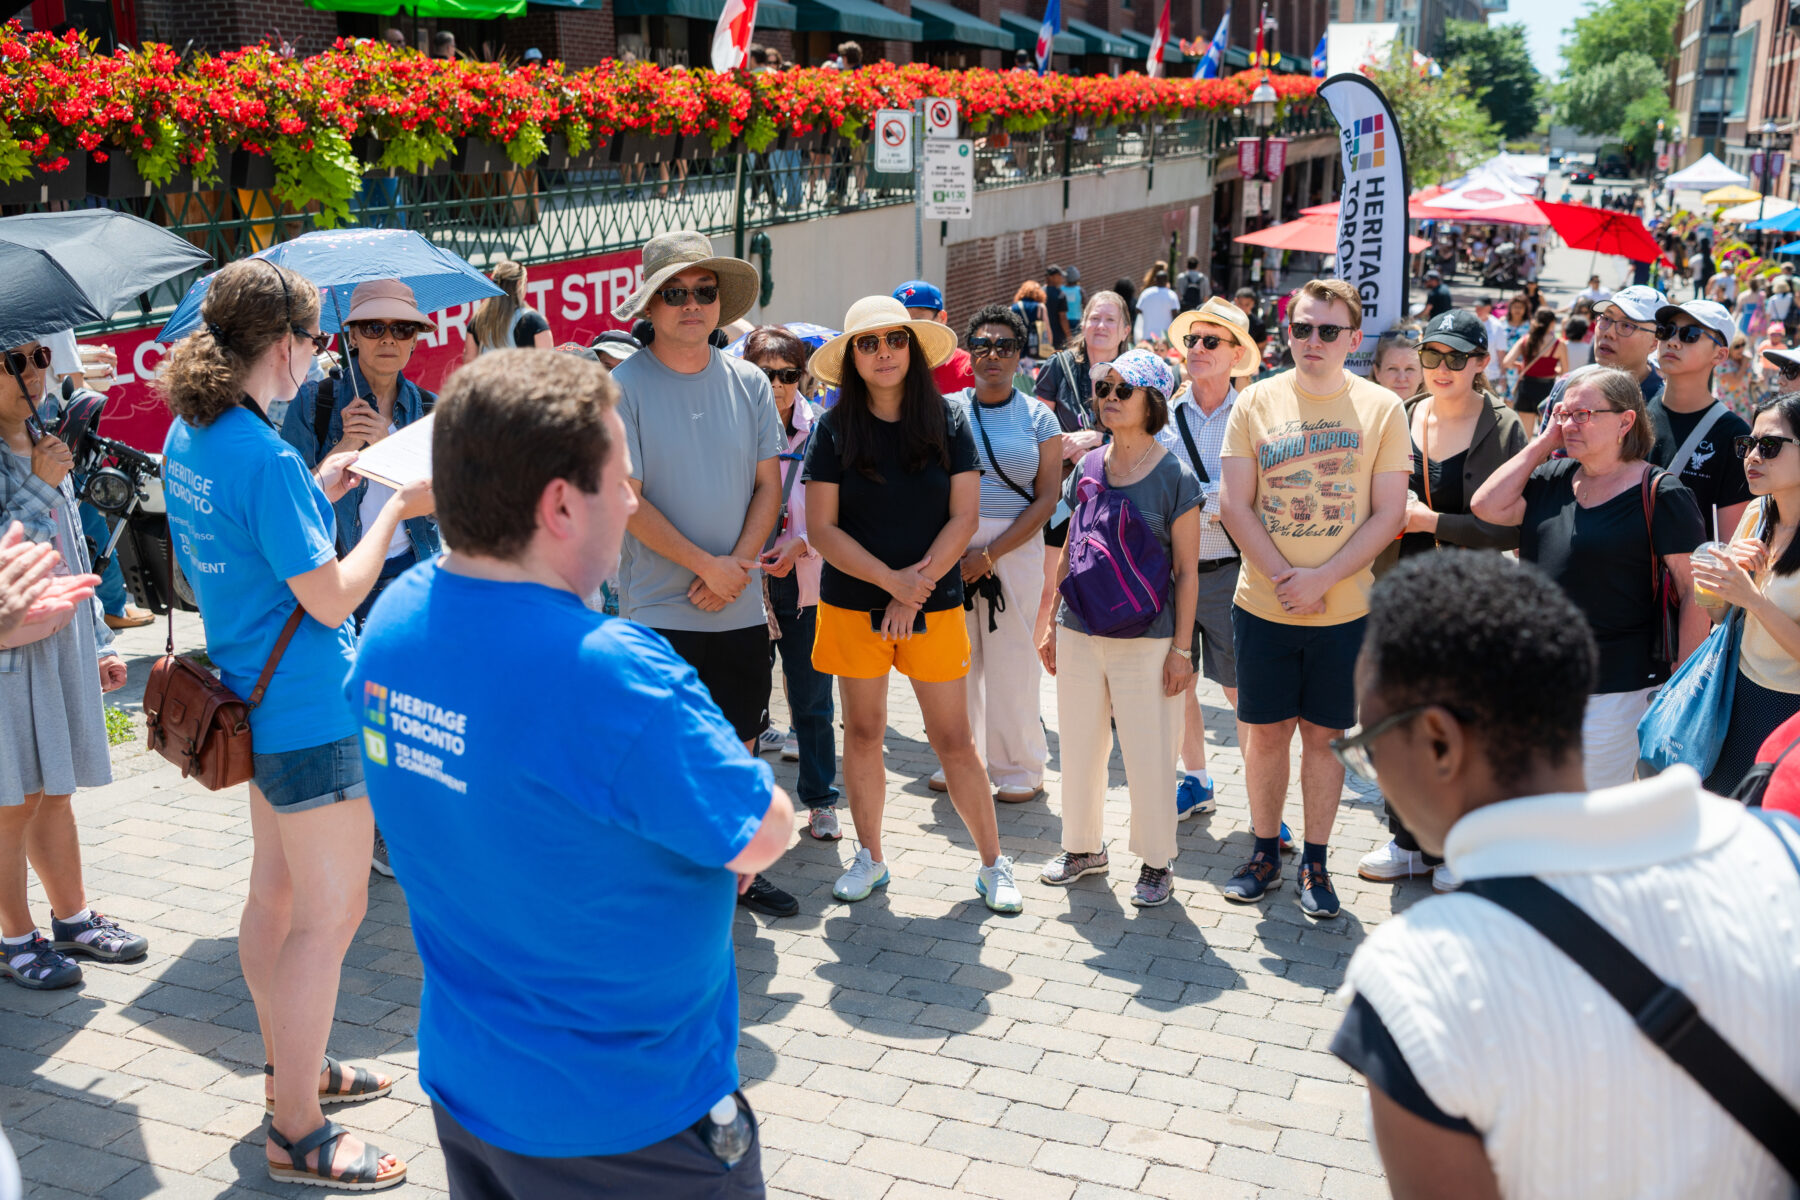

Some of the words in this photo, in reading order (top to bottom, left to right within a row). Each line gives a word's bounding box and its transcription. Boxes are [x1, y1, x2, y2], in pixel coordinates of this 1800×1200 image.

[1339, 180, 1361, 283] TORON
[1357, 176, 1386, 318] HERITAGE
[561, 267, 644, 321] STR
[1279, 418, 1343, 436] Fabulous
[1260, 435, 1306, 471] GRAND
[1309, 431, 1360, 454] RAPIDS
[1268, 520, 1294, 534] Best
[1292, 523, 1326, 538] West
[1325, 525, 1344, 537] MI
[1294, 513, 1311, 521] USA
[390, 690, 468, 735] HERITAGE
[390, 711, 466, 756] TORONTO
